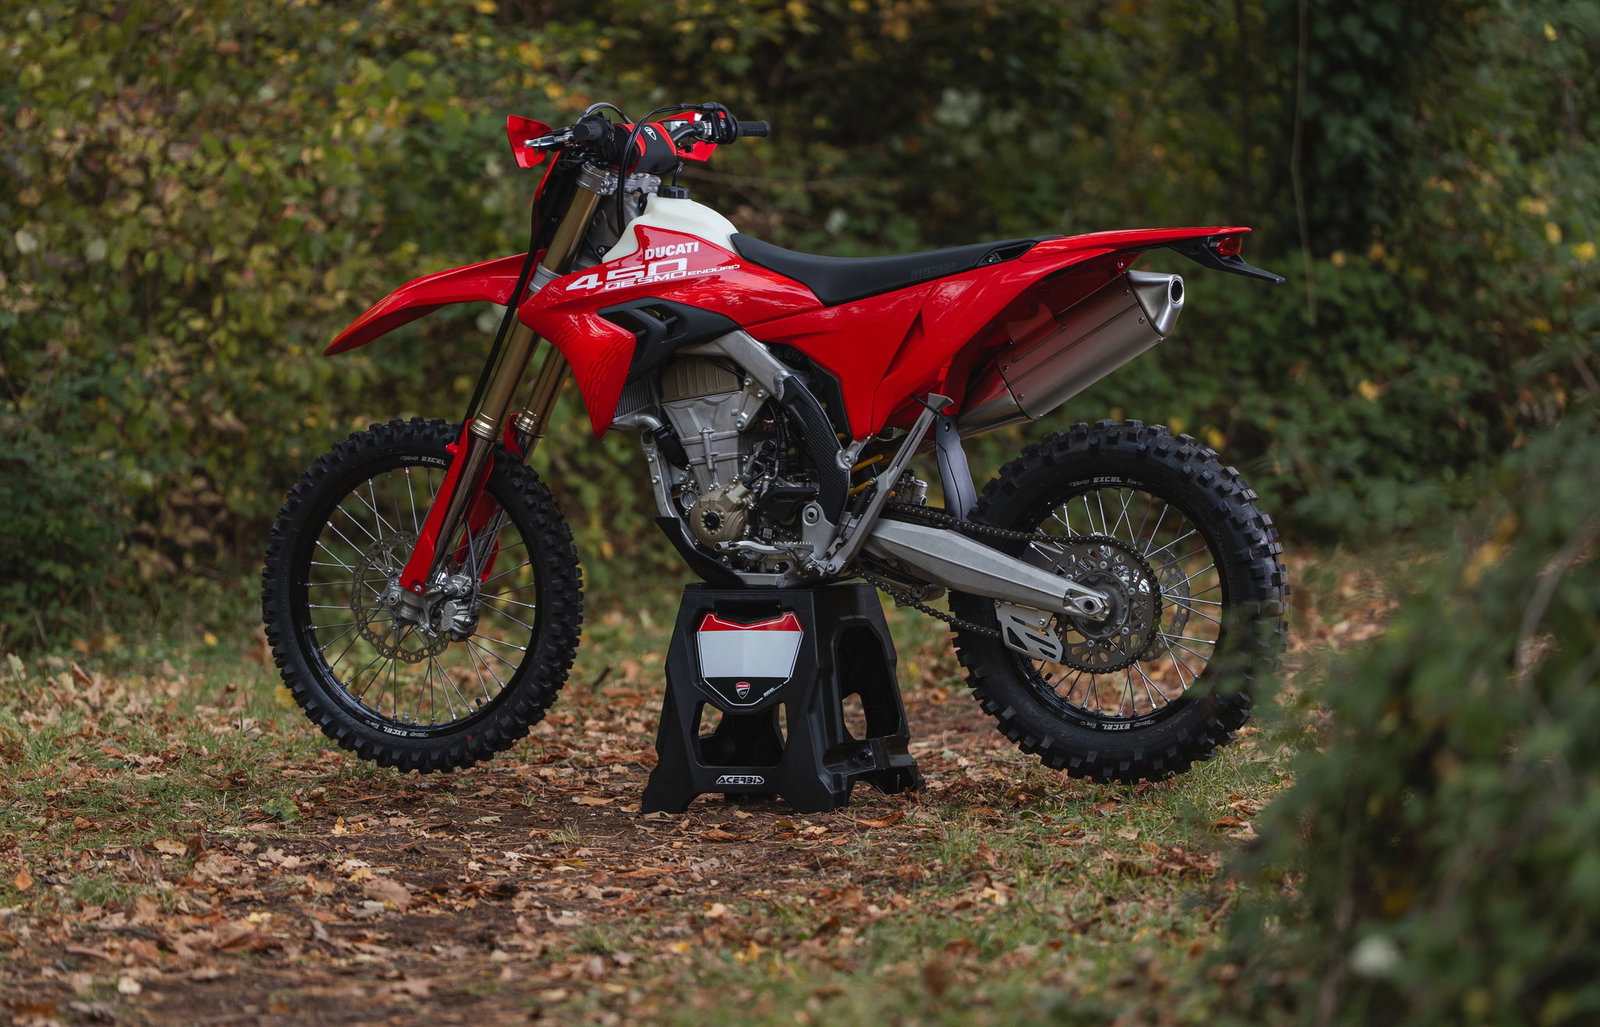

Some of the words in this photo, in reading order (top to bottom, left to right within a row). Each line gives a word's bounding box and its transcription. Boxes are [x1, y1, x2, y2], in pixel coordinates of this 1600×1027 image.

[644, 241, 699, 261] DUCATI
[566, 257, 688, 291] 450
[604, 270, 687, 291] DESMO
[687, 264, 740, 276] ENDURO
[421, 455, 446, 466] EXCEL
[383, 726, 408, 737] EXCEL
[1101, 723, 1131, 731] EXCEL
[715, 775, 765, 785] ACERBIS
